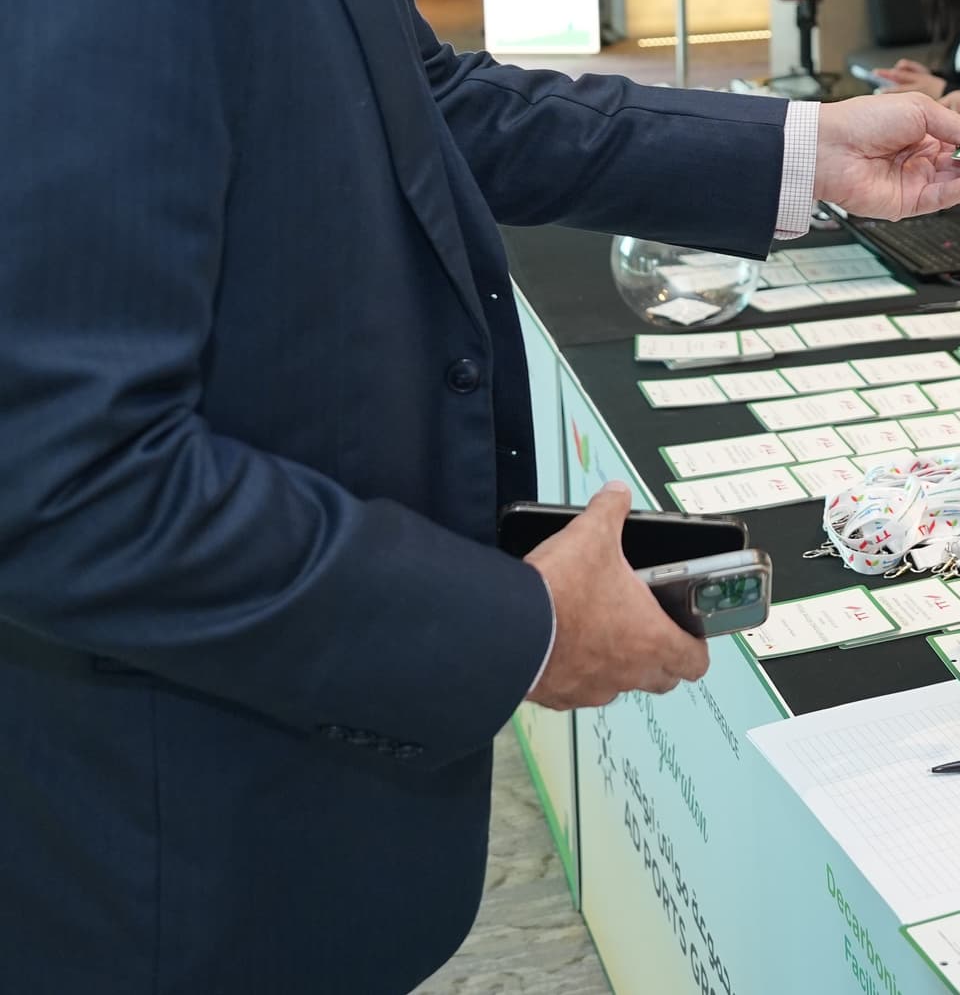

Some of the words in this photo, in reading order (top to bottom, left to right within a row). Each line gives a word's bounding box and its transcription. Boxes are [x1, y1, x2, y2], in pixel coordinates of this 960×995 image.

[645, 693, 709, 844] Registration
[624, 800, 641, 853] AD
[643, 837, 687, 956] PORTS
[690, 942, 718, 995] GR
[691, 888, 737, 995] جموعة
[825, 862, 904, 995] Decarboni
[844, 933, 880, 995] Facili
